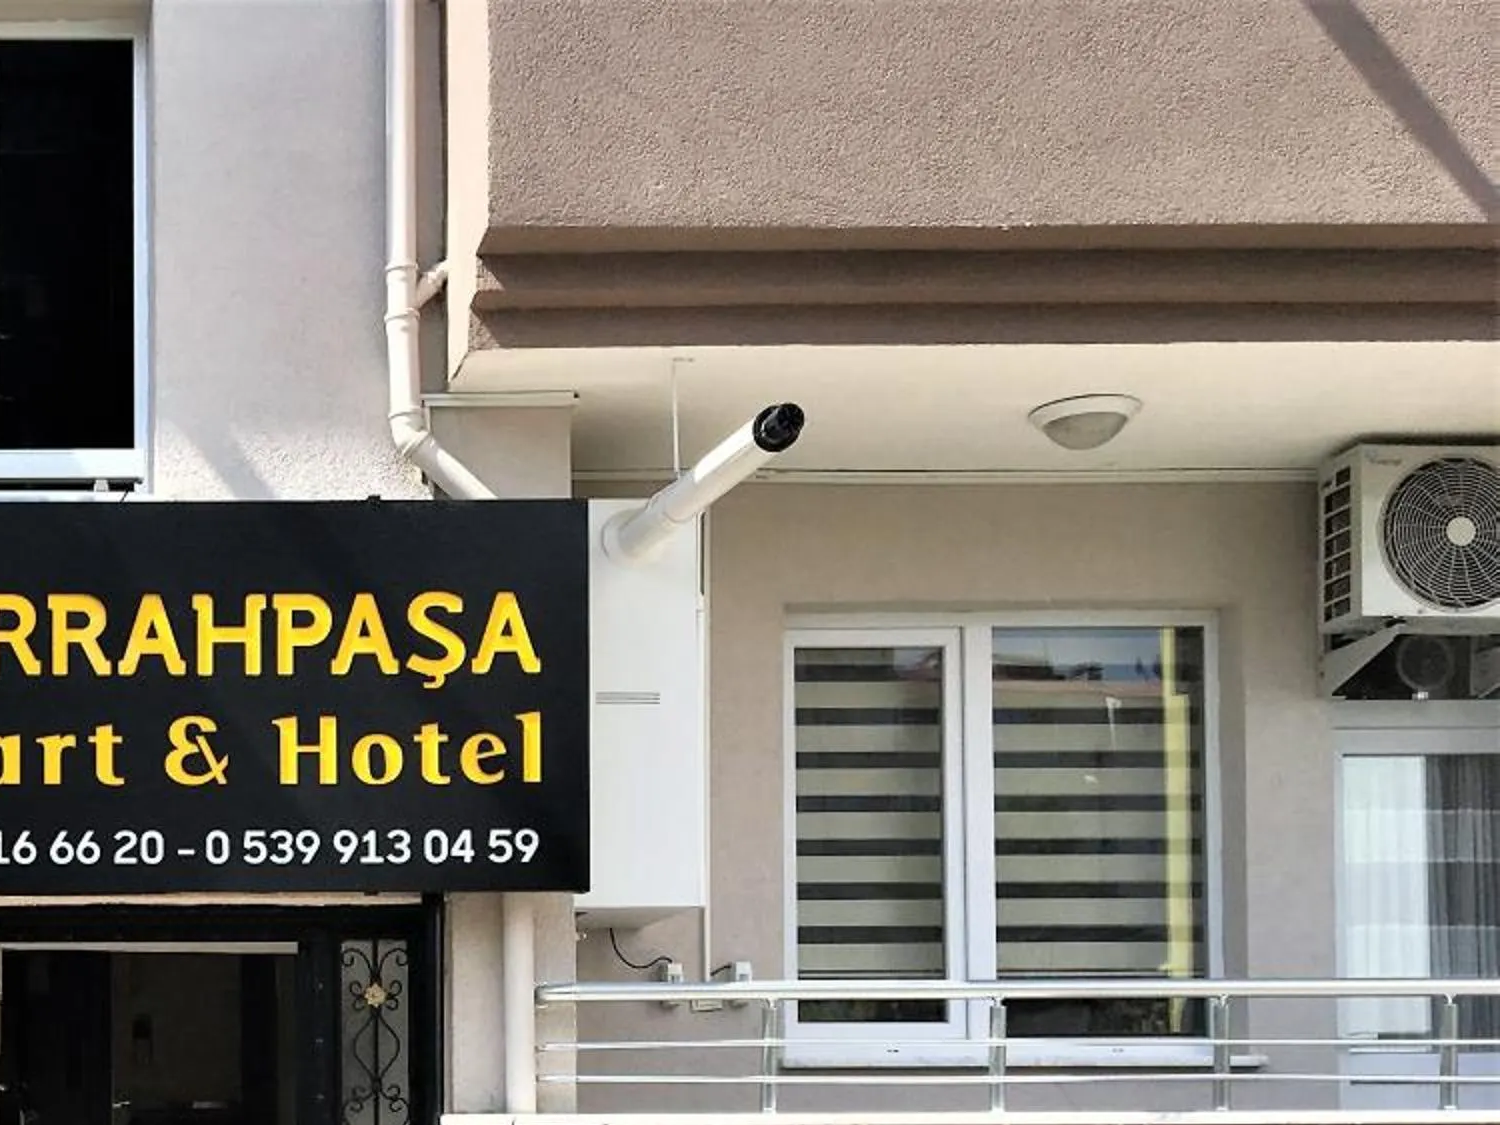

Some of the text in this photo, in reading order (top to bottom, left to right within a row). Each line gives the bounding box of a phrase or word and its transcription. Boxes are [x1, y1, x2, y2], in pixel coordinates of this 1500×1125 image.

[164, 715, 229, 786] &
[271, 711, 542, 785] Hotel
[49, 830, 101, 865] 66
[113, 829, 165, 865] 20
[205, 829, 230, 865] 0
[243, 829, 321, 865] 539
[332, 829, 412, 865] 913
[423, 828, 476, 865] 04
[488, 828, 540, 864] 59
